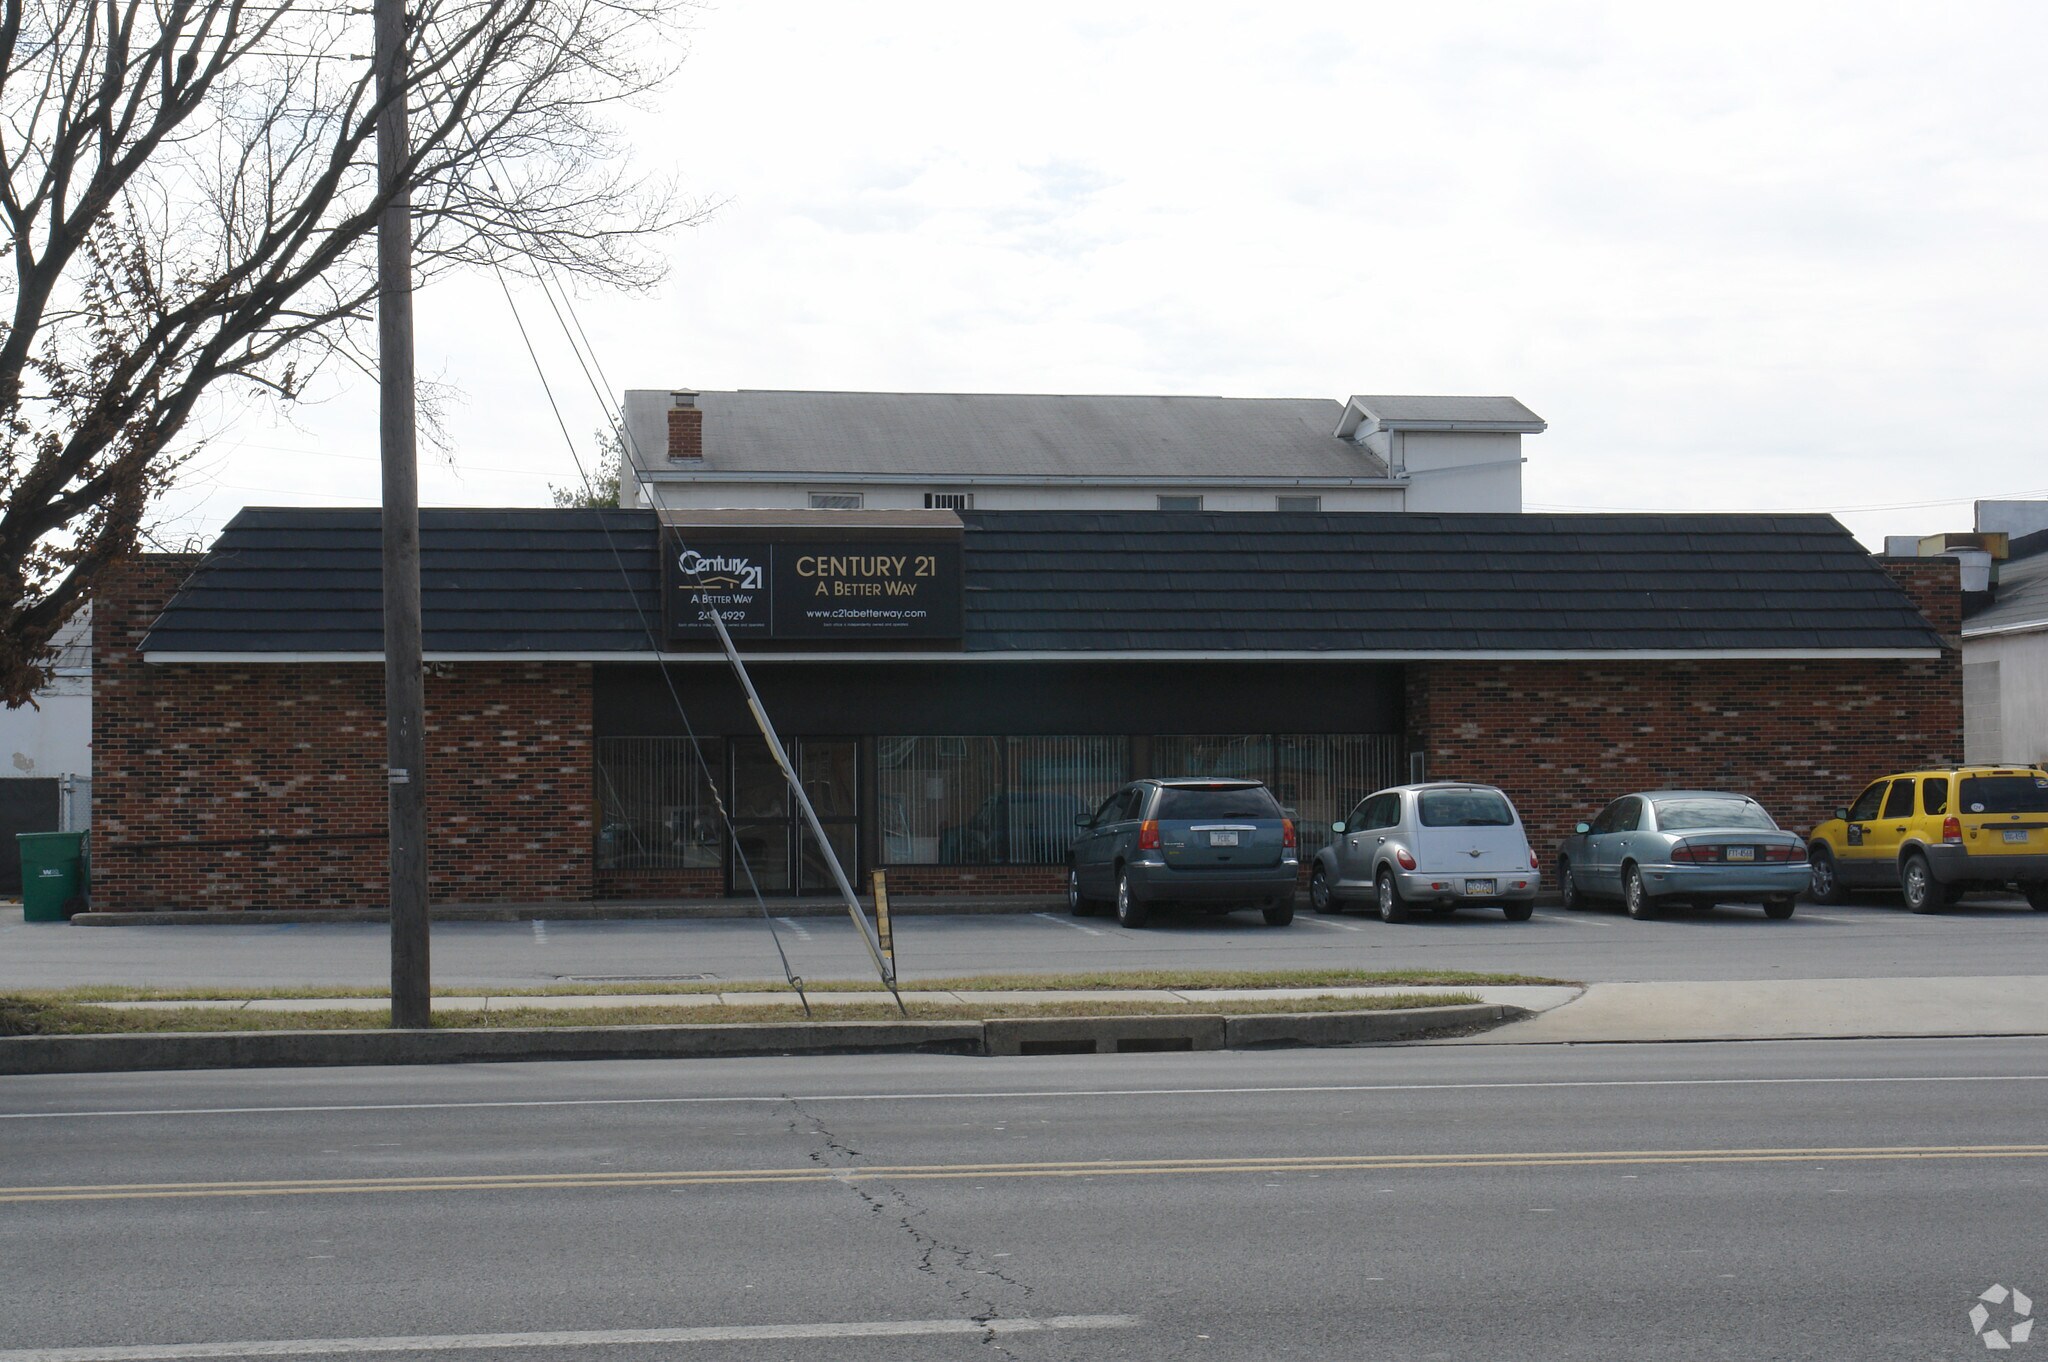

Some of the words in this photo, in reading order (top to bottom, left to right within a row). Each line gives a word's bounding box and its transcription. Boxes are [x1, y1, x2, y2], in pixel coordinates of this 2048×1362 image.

[678, 550, 749, 575] Century
[796, 555, 907, 577] CENTURY
[914, 555, 936, 577] 21
[740, 566, 762, 589] 21
[815, 580, 829, 596] A
[834, 580, 881, 596] BETTER
[884, 580, 917, 596] WAY
[690, 594, 700, 604] A
[702, 594, 731, 604] BETTER
[732, 594, 753, 604] WAY
[806, 608, 927, 620] www.c21abetterway.com
